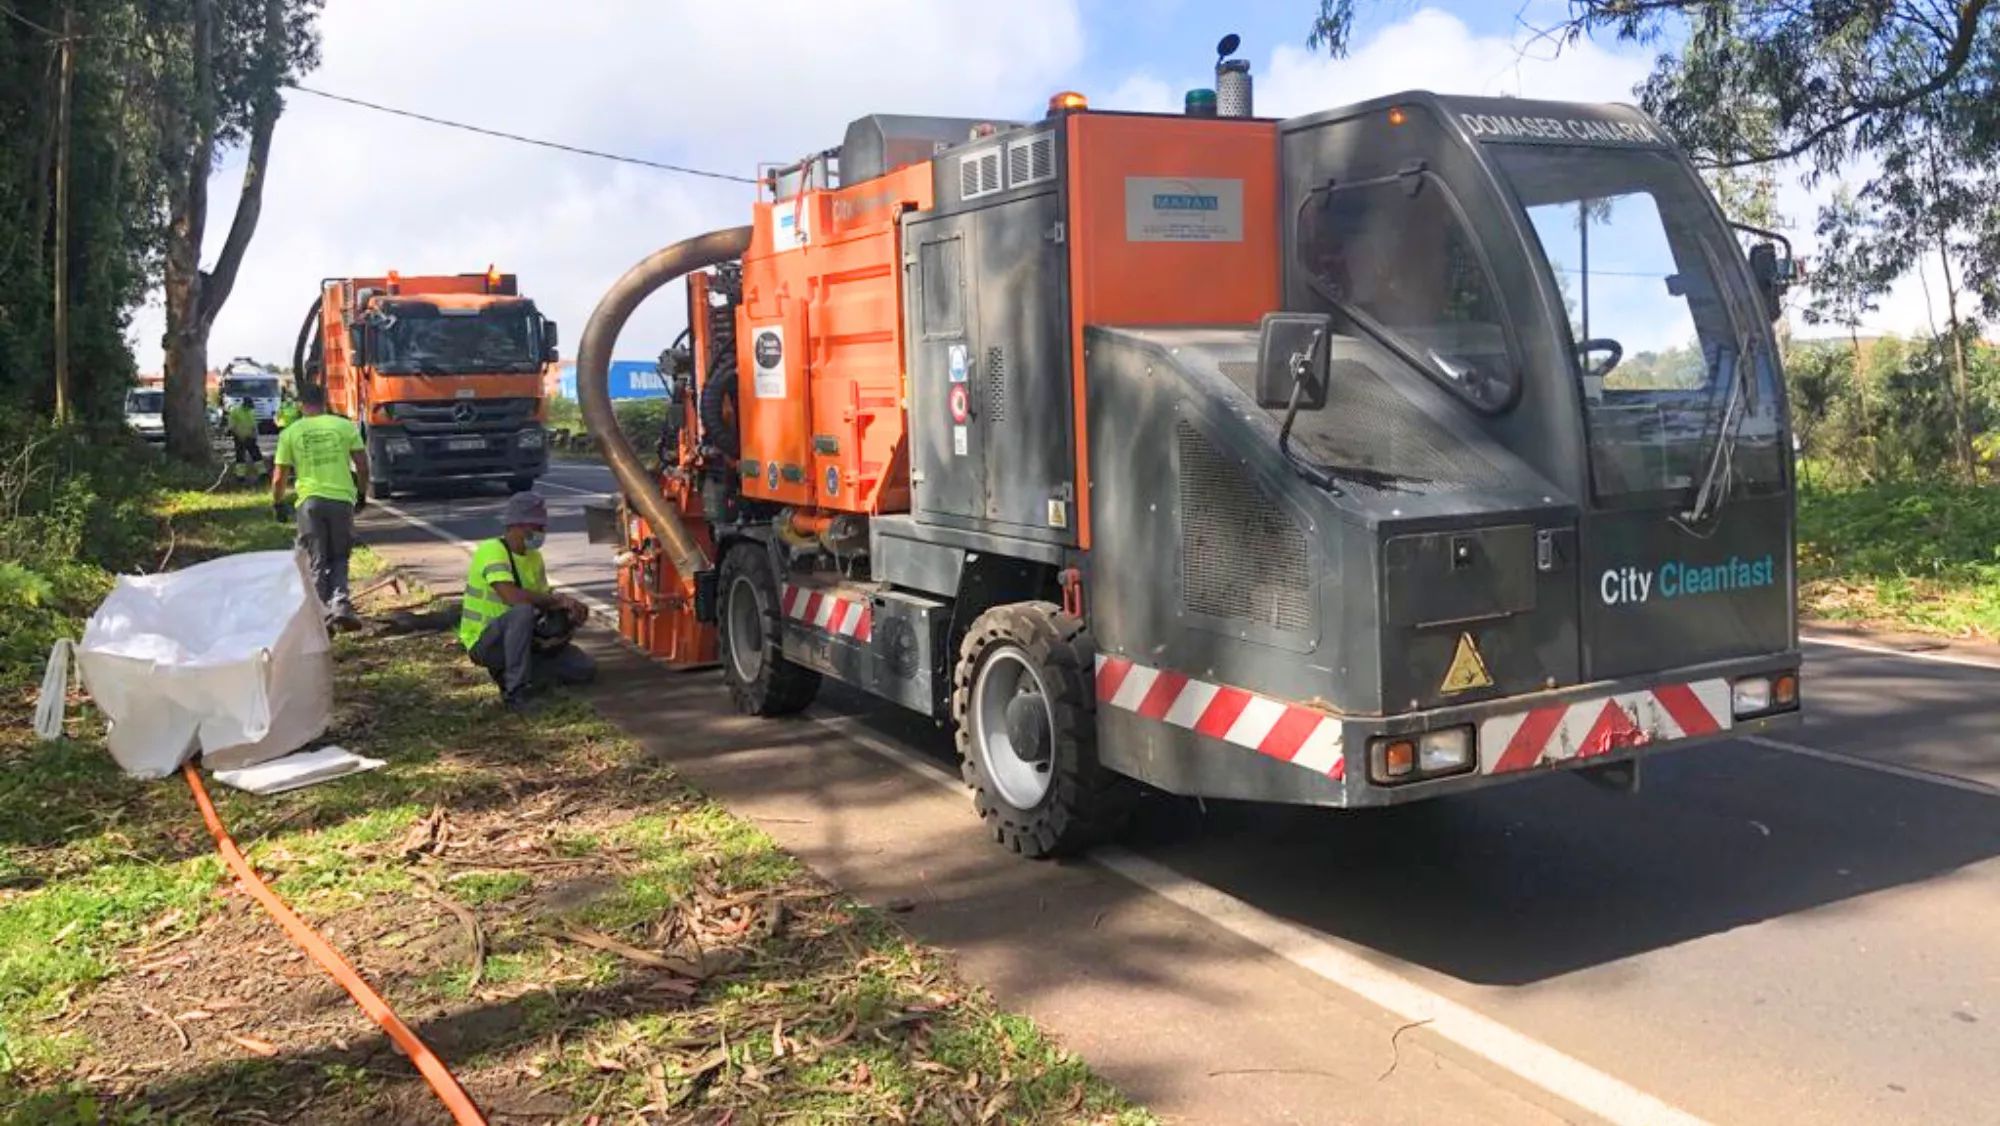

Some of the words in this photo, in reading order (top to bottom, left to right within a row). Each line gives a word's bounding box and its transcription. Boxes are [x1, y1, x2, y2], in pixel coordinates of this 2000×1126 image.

[1460, 113, 1573, 138] DOMASER
[1600, 566, 1653, 605] City
[1659, 554, 1773, 598] Cleanfast
